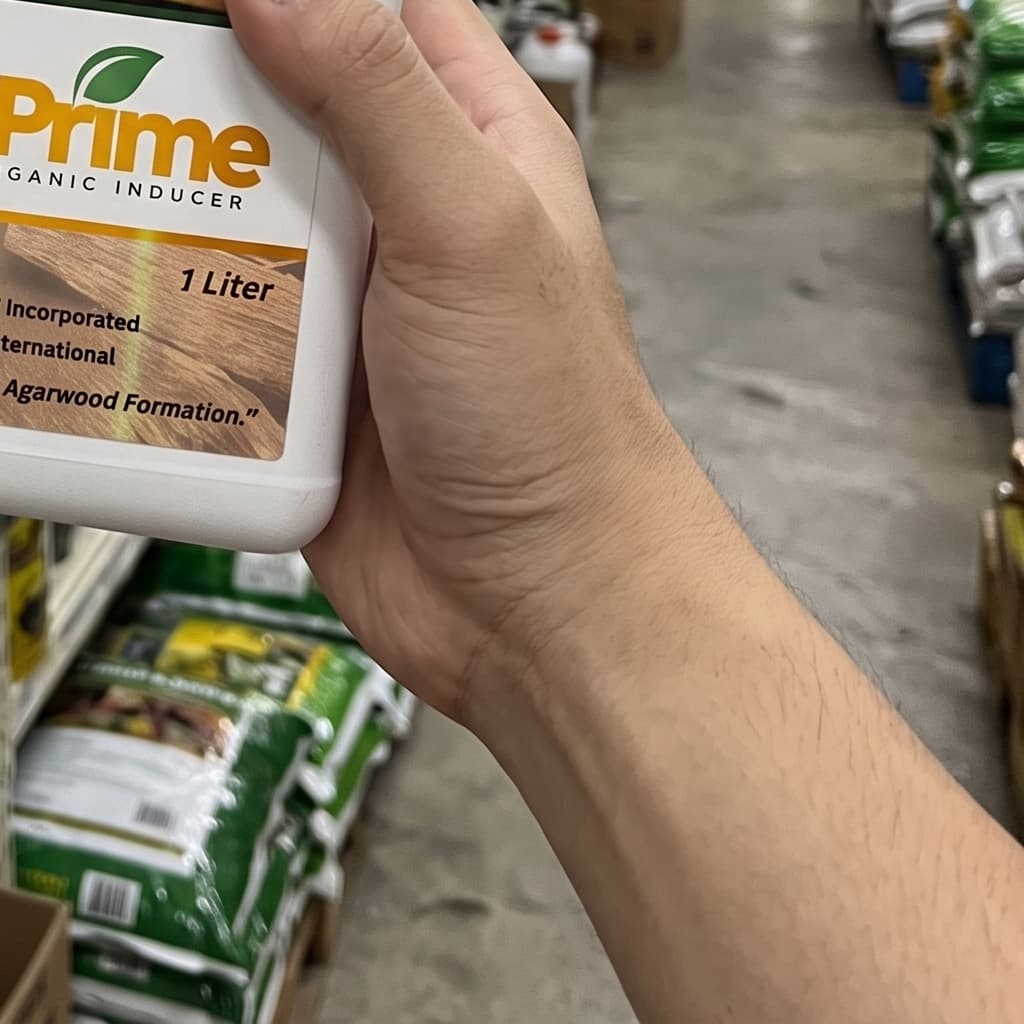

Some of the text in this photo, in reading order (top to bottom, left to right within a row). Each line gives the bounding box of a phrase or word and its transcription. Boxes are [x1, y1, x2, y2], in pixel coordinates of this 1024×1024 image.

[115, 179, 244, 211] INDUCER
[180, 267, 274, 303] 1 Liter
[6, 298, 141, 334] Incorporated
[3, 378, 118, 414] Agarwood
[122, 392, 259, 428] Formation.”
